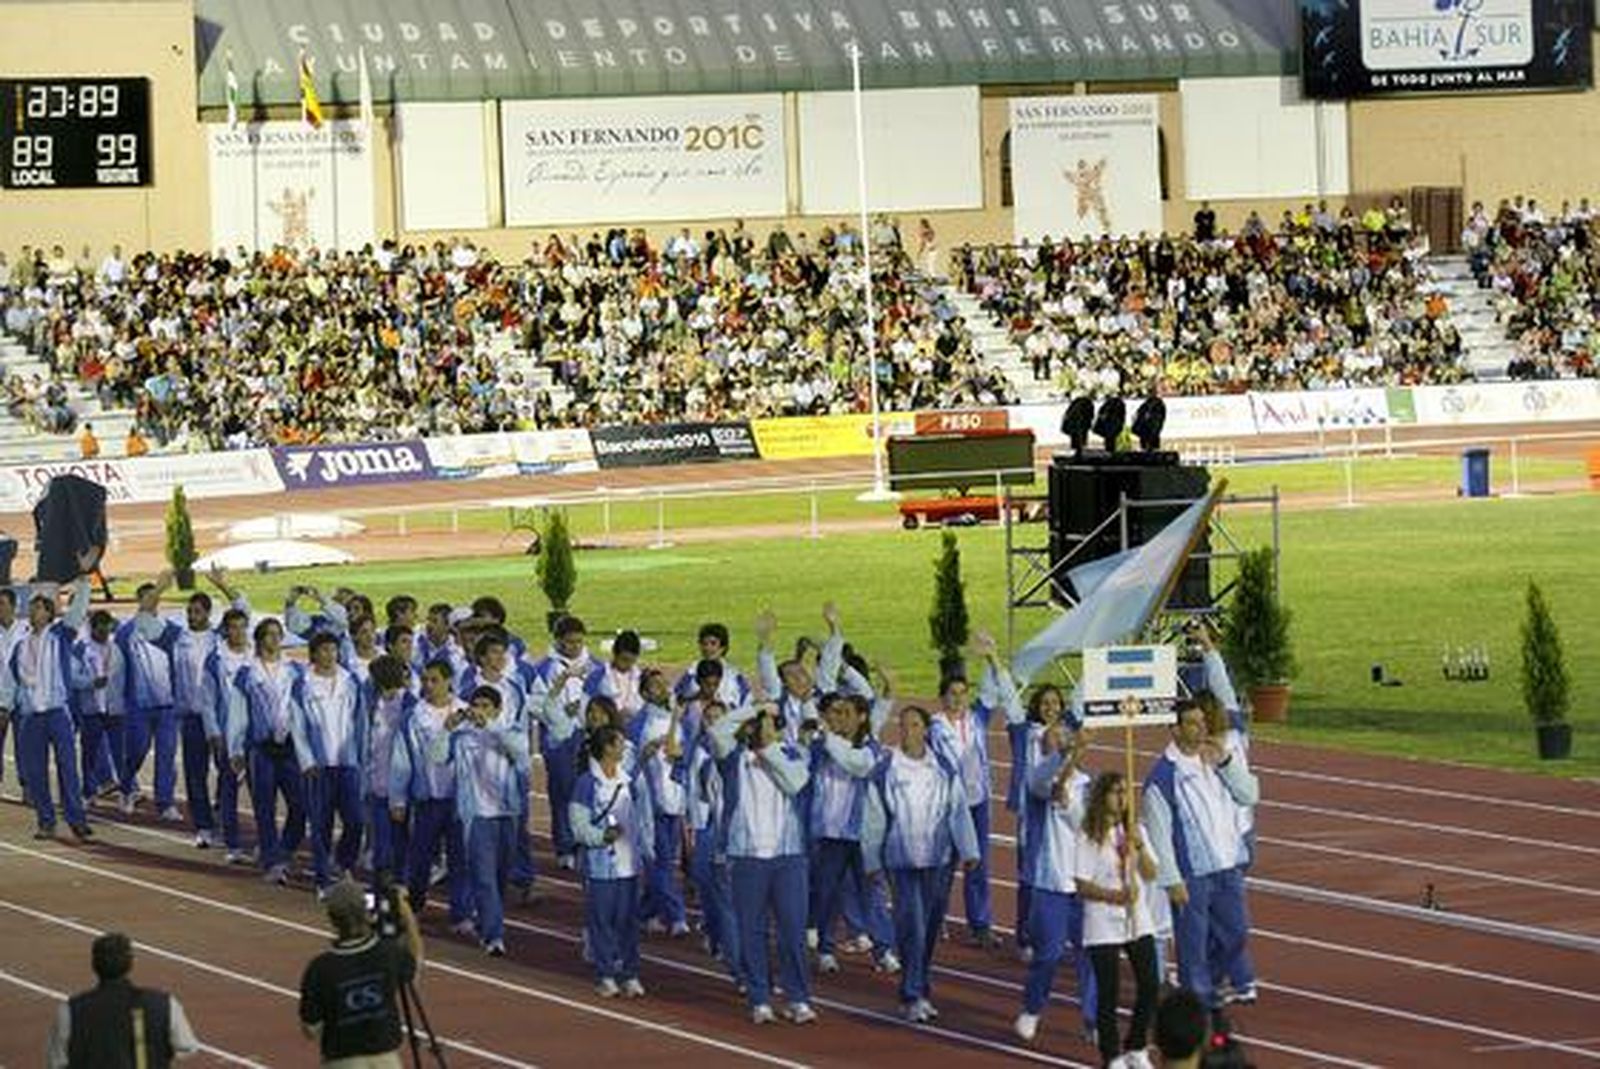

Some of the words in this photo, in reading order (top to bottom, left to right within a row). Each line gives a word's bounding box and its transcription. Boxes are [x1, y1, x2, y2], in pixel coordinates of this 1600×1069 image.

[288, 22, 496, 43] CIUDAD
[545, 10, 850, 39] DEPORTIVA
[1100, 2, 1194, 25] SUR
[1476, 22, 1522, 45] SUR
[737, 45, 794, 64] DE
[982, 33, 1240, 59] FERNANDO
[1371, 75, 1388, 86] DE
[1392, 74, 1428, 85] TODO
[1431, 72, 1473, 86] JUNTO
[1476, 72, 1493, 82] AL
[1497, 70, 1526, 81] MAR
[1045, 103, 1119, 118] FERNANDO
[525, 130, 567, 147] SAN
[569, 126, 680, 146] FERNANDO
[13, 135, 53, 167] 89
[96, 133, 137, 166] 99
[11, 168, 56, 185] LOCAL
[941, 413, 981, 430] PESO
